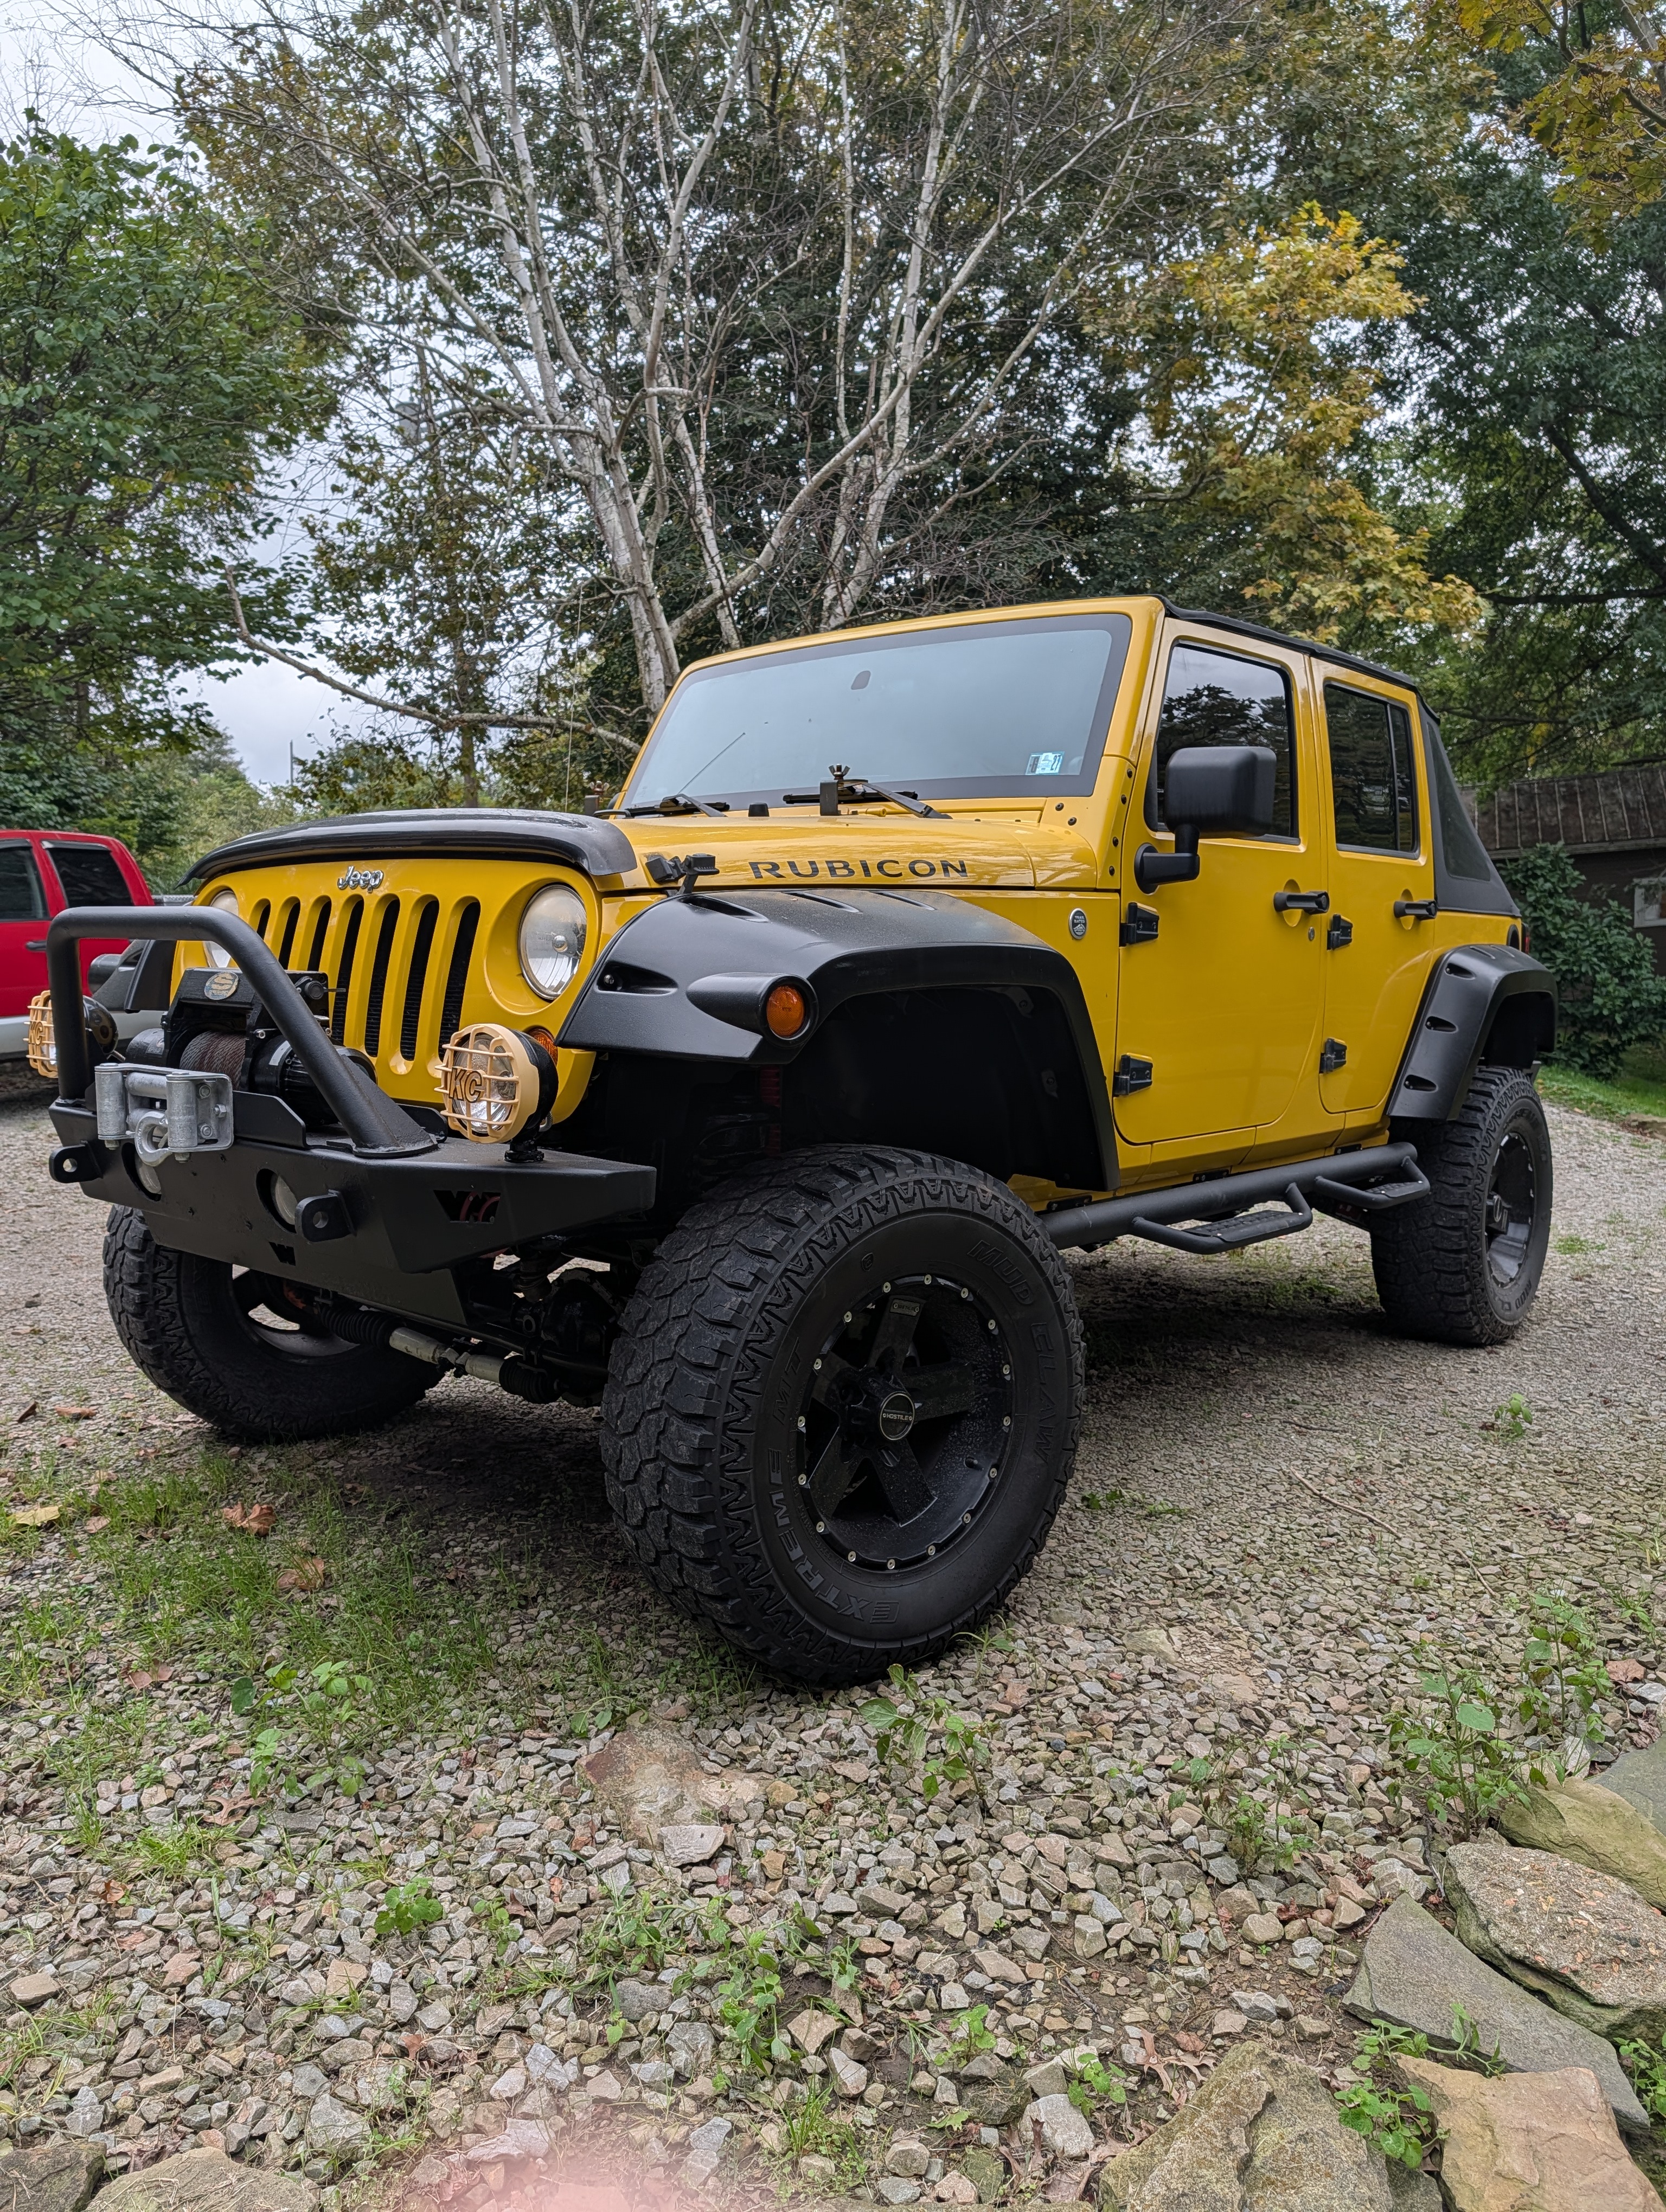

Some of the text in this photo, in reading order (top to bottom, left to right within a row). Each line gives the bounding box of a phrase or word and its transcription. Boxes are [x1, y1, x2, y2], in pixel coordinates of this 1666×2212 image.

[337, 866, 384, 893] Jeep
[748, 859, 968, 879] RUBICON
[28, 1021, 43, 1045] KC
[448, 1066, 483, 1103] KC
[966, 1239, 1056, 1464] MUD CLAW
[886, 1413, 909, 1421] HOSTILE
[768, 1448, 900, 1625] EXTREME
